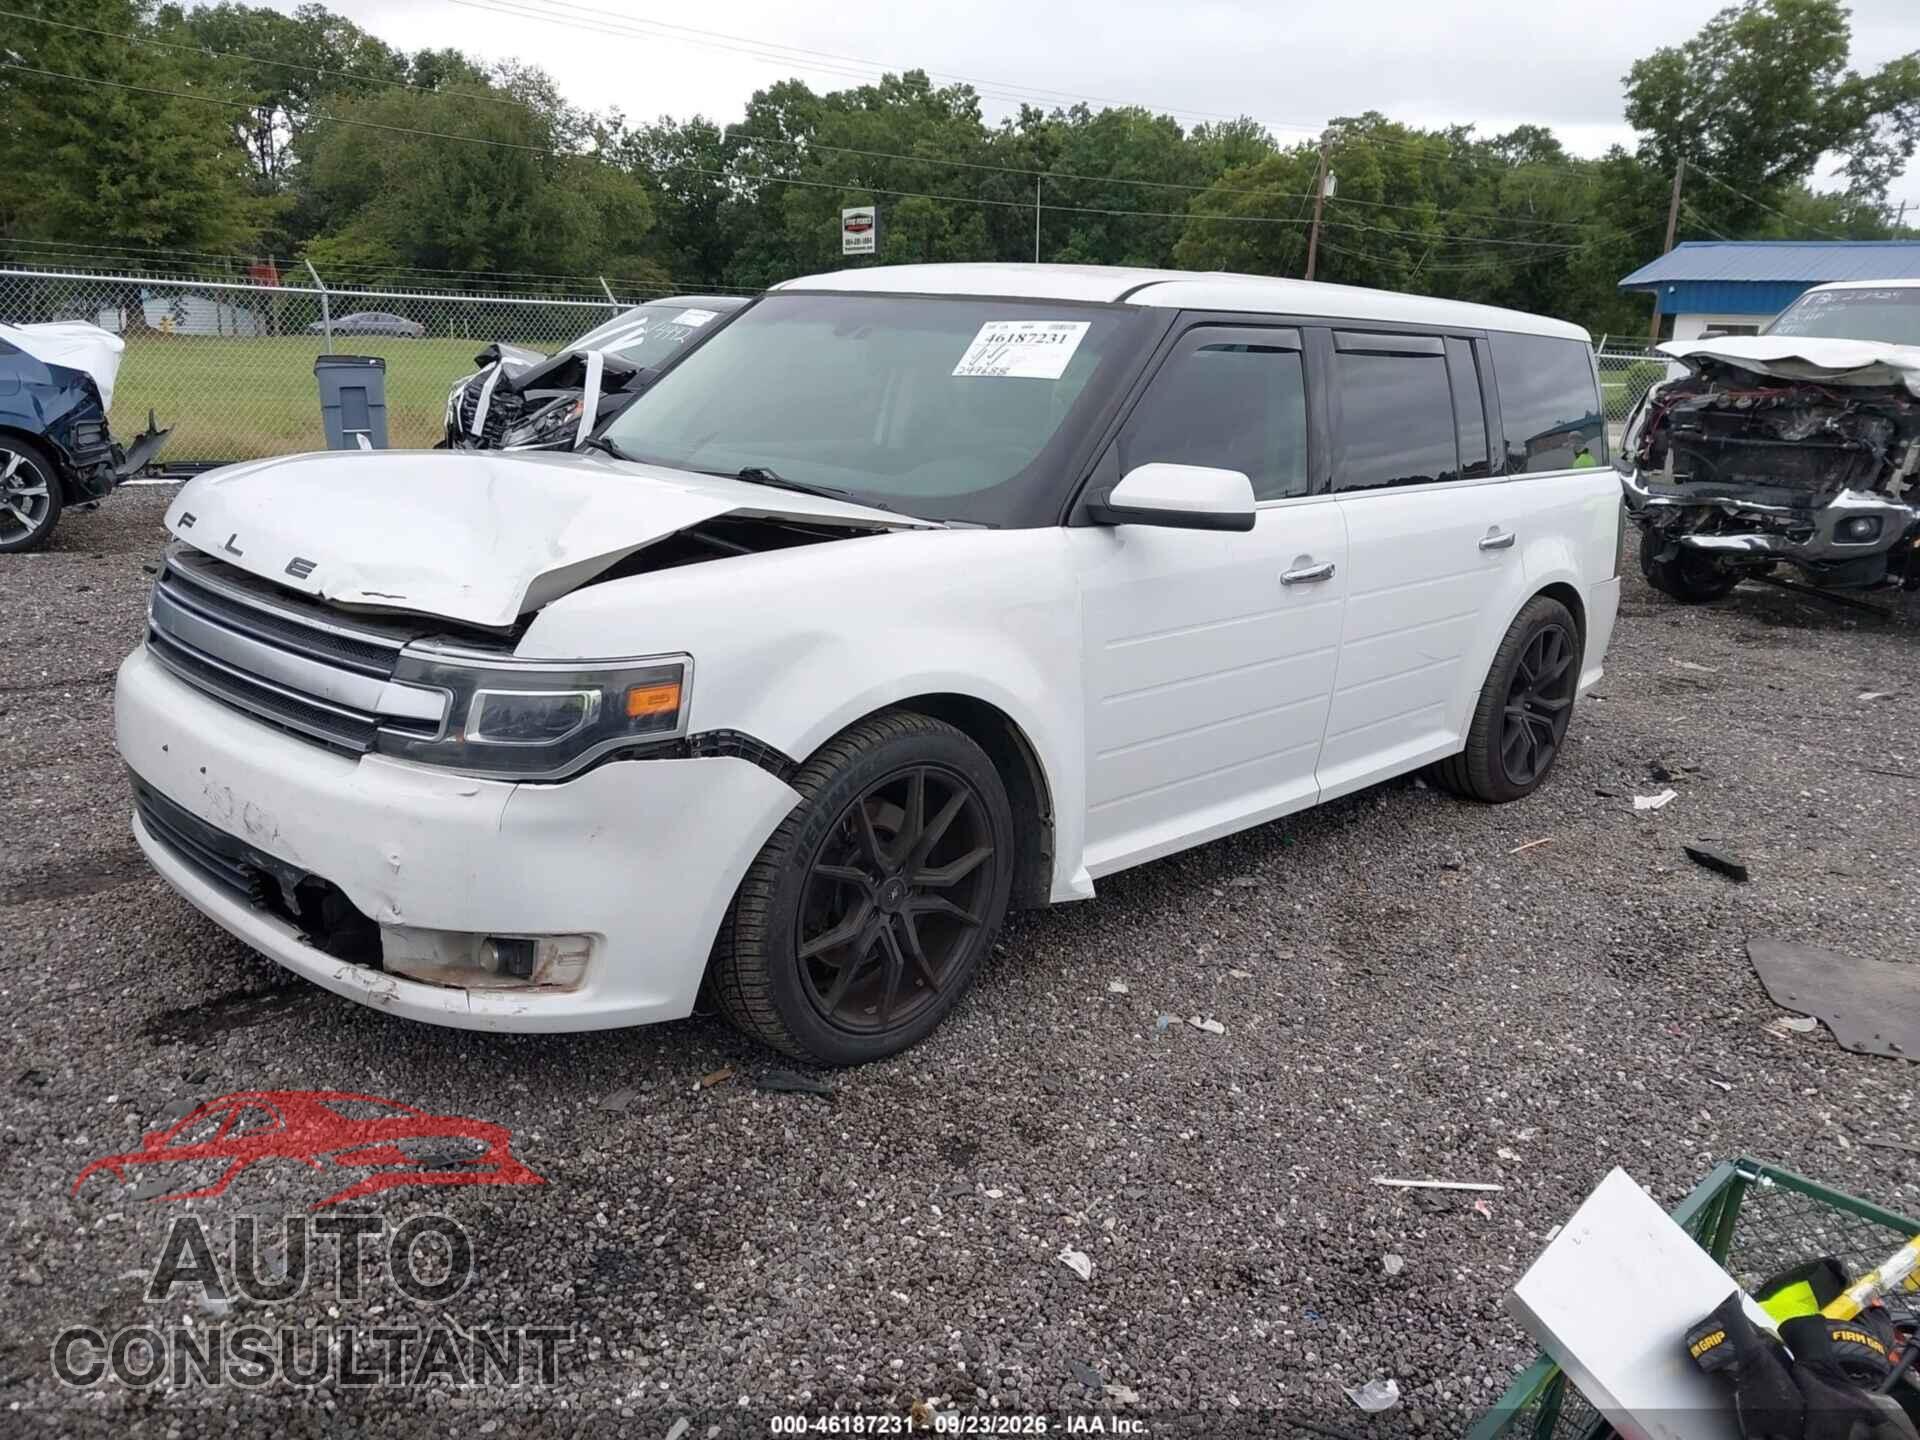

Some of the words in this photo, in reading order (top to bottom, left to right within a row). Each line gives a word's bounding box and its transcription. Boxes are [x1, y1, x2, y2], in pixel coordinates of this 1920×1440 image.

[985, 332, 1068, 345] 46187231
[1698, 1330, 1726, 1351] GRIP
[1832, 1330, 1866, 1344] FIRM
